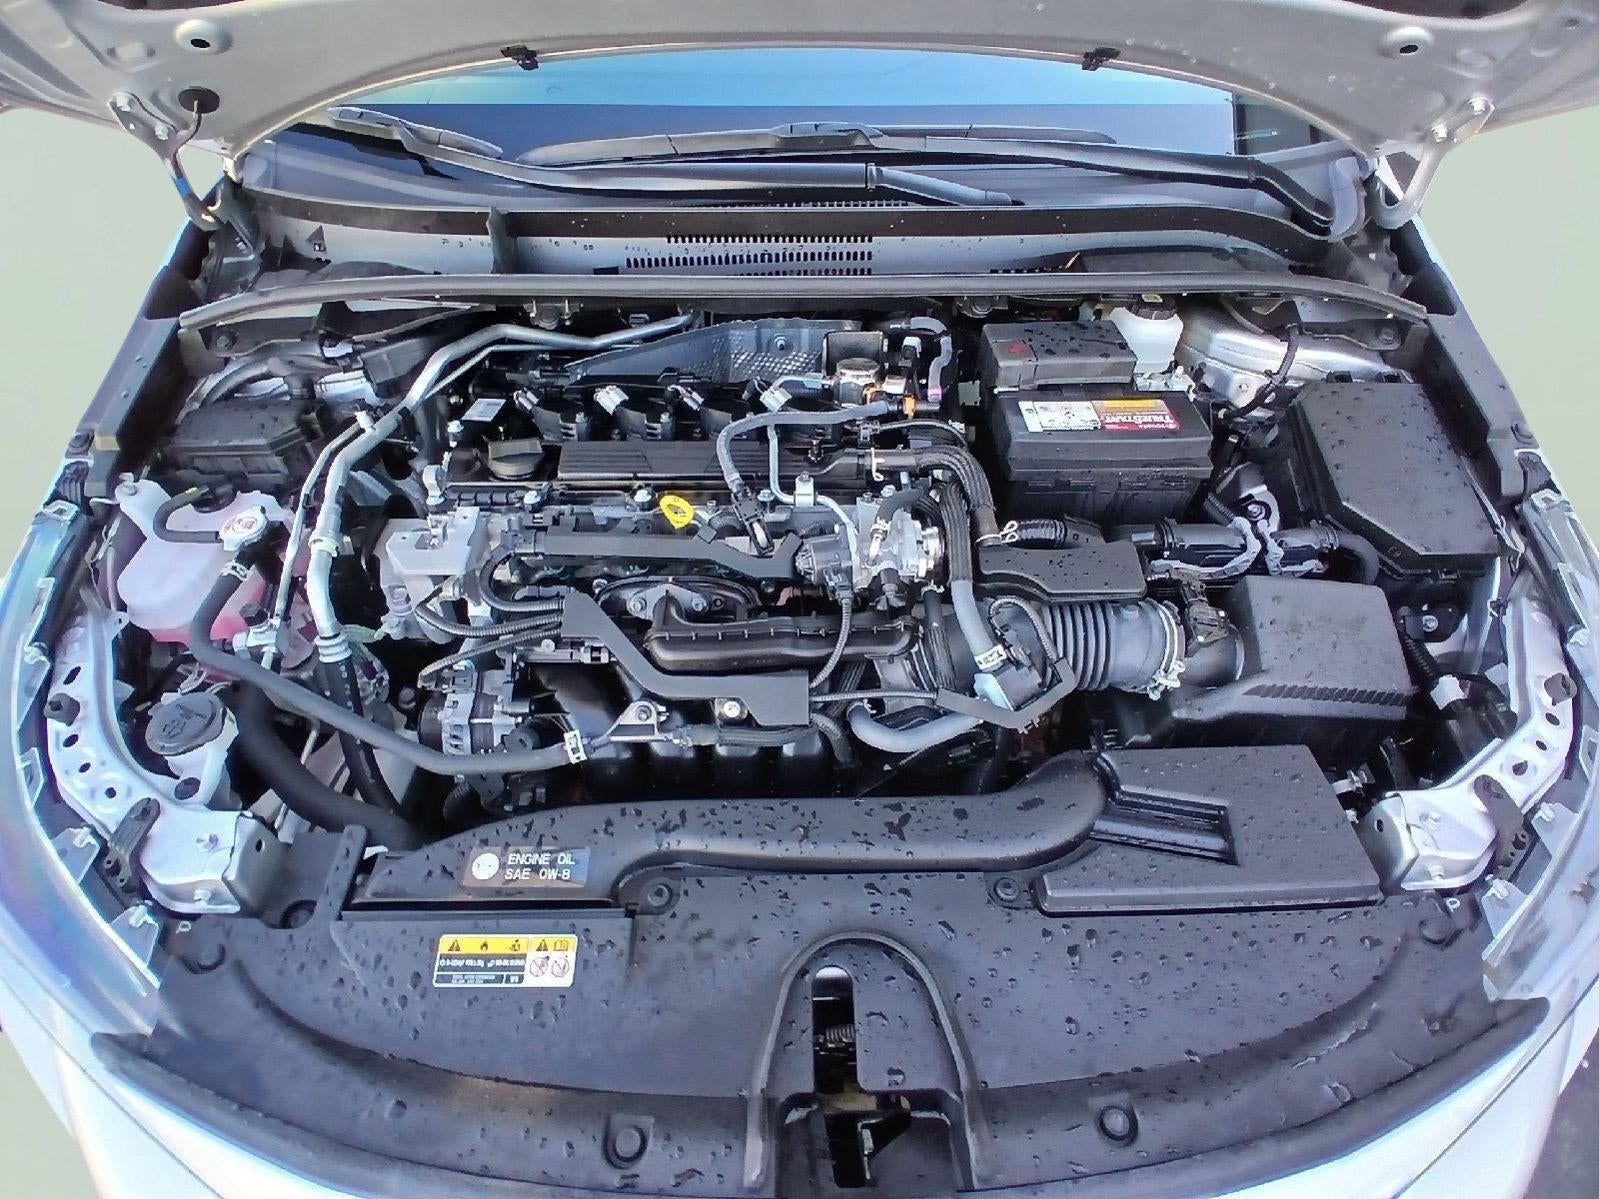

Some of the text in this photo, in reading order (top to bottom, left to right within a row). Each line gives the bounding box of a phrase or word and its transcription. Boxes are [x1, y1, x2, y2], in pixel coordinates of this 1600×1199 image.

[507, 852, 551, 866] ENGINE
[557, 852, 576, 866] OIL
[504, 868, 531, 880] SAE
